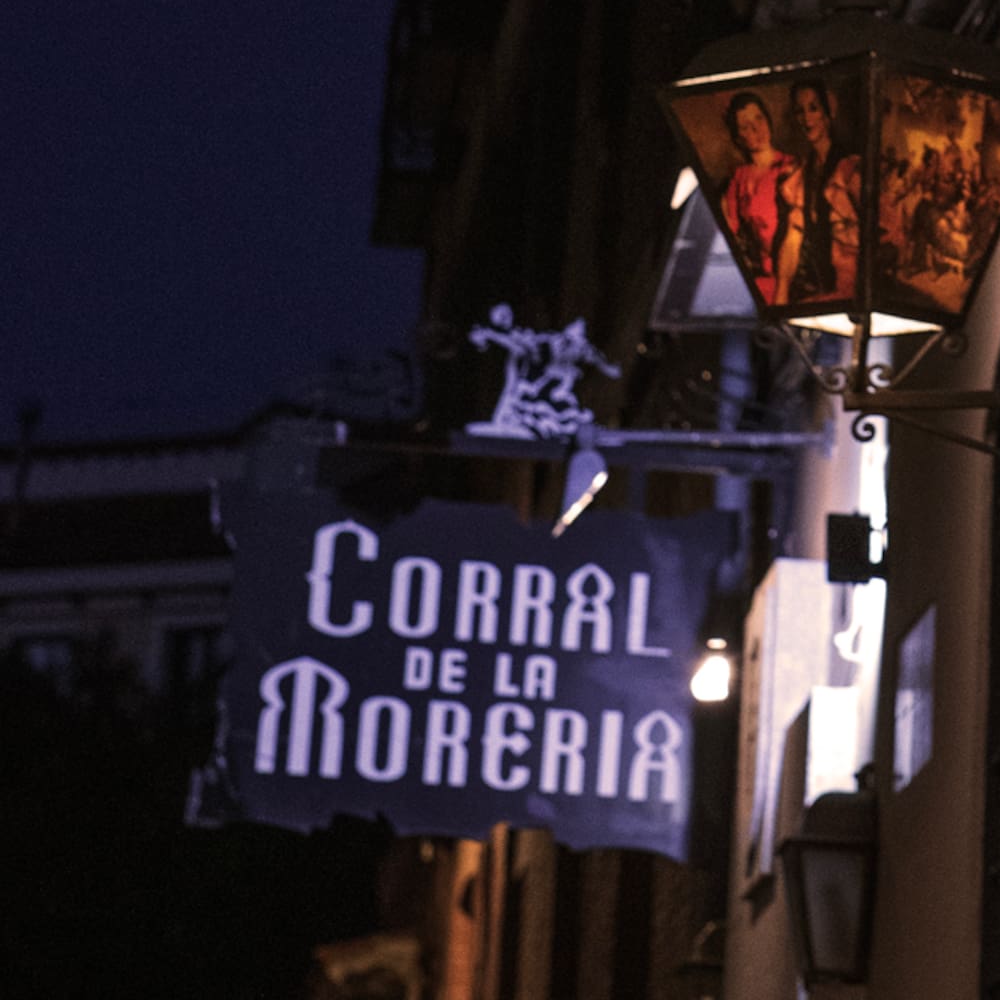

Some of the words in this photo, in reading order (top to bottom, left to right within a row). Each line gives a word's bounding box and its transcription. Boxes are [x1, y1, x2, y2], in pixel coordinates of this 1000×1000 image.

[306, 519, 671, 656] CORRAL
[254, 656, 683, 801] MORERIA
[404, 646, 468, 693] DE
[494, 653, 558, 700] LA
